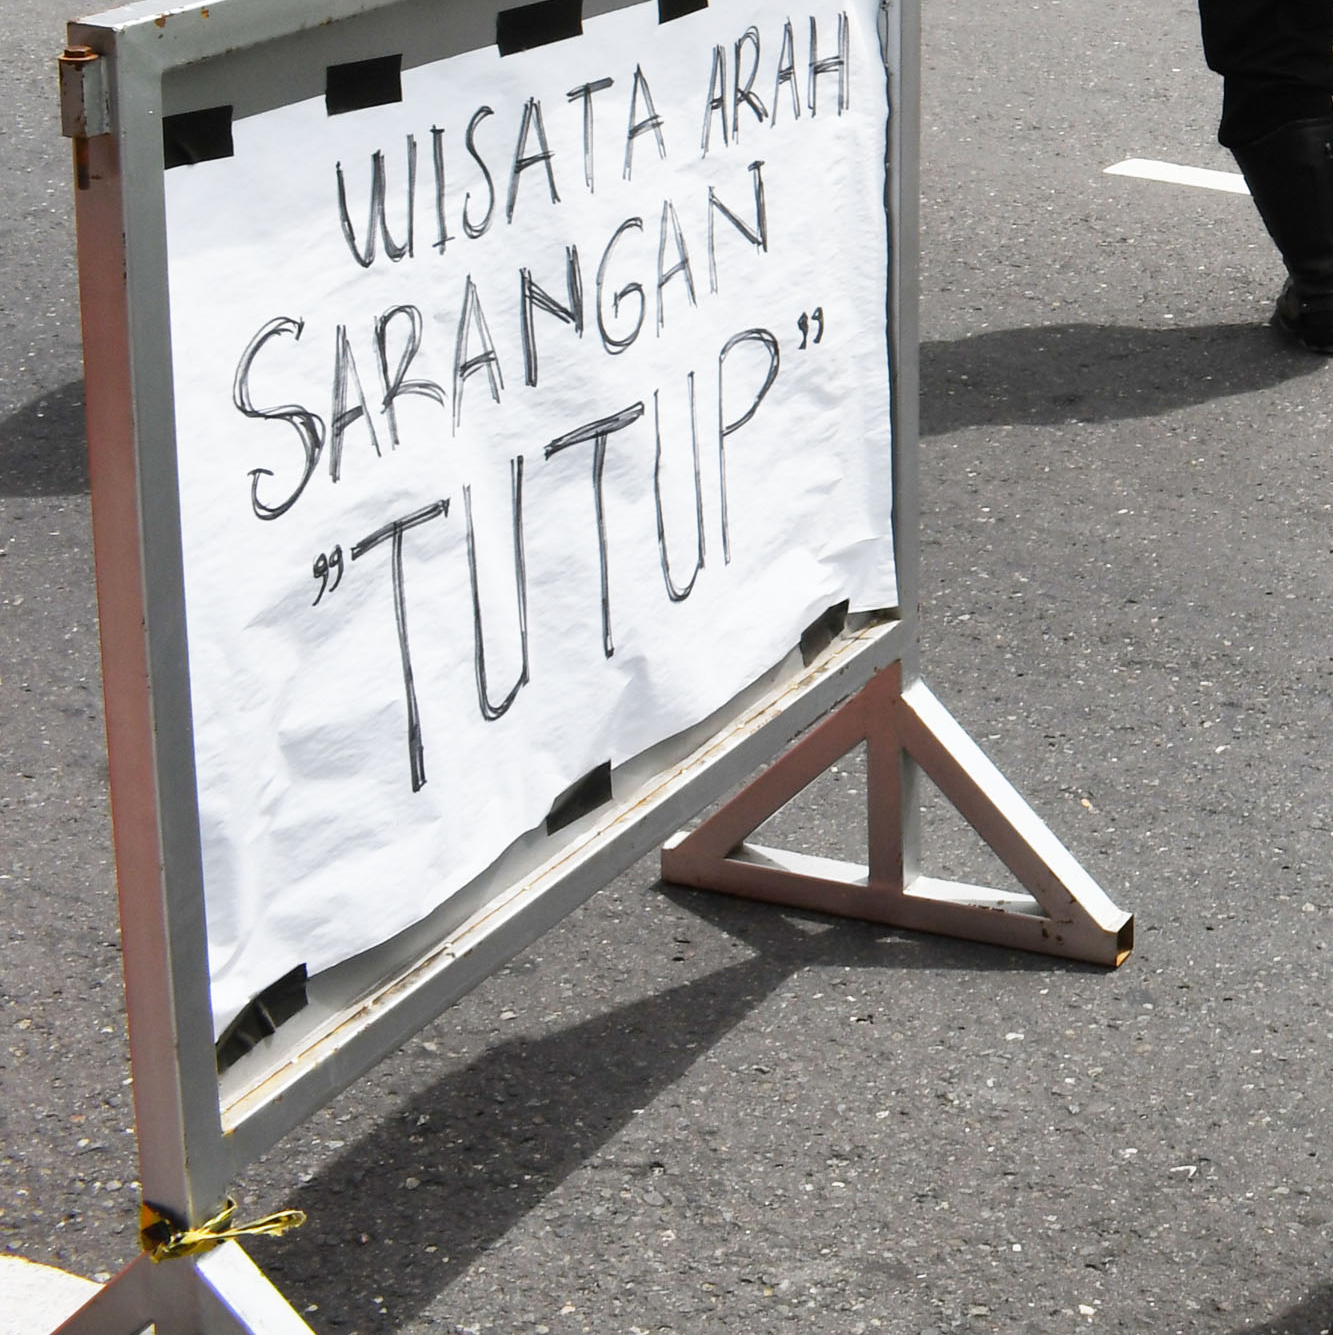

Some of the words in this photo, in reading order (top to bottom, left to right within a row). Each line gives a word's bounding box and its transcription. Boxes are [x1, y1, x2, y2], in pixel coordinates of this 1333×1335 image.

[336, 63, 667, 268] WISATA
[701, 11, 850, 159] ARAH
[233, 160, 768, 520] SARANGAN
